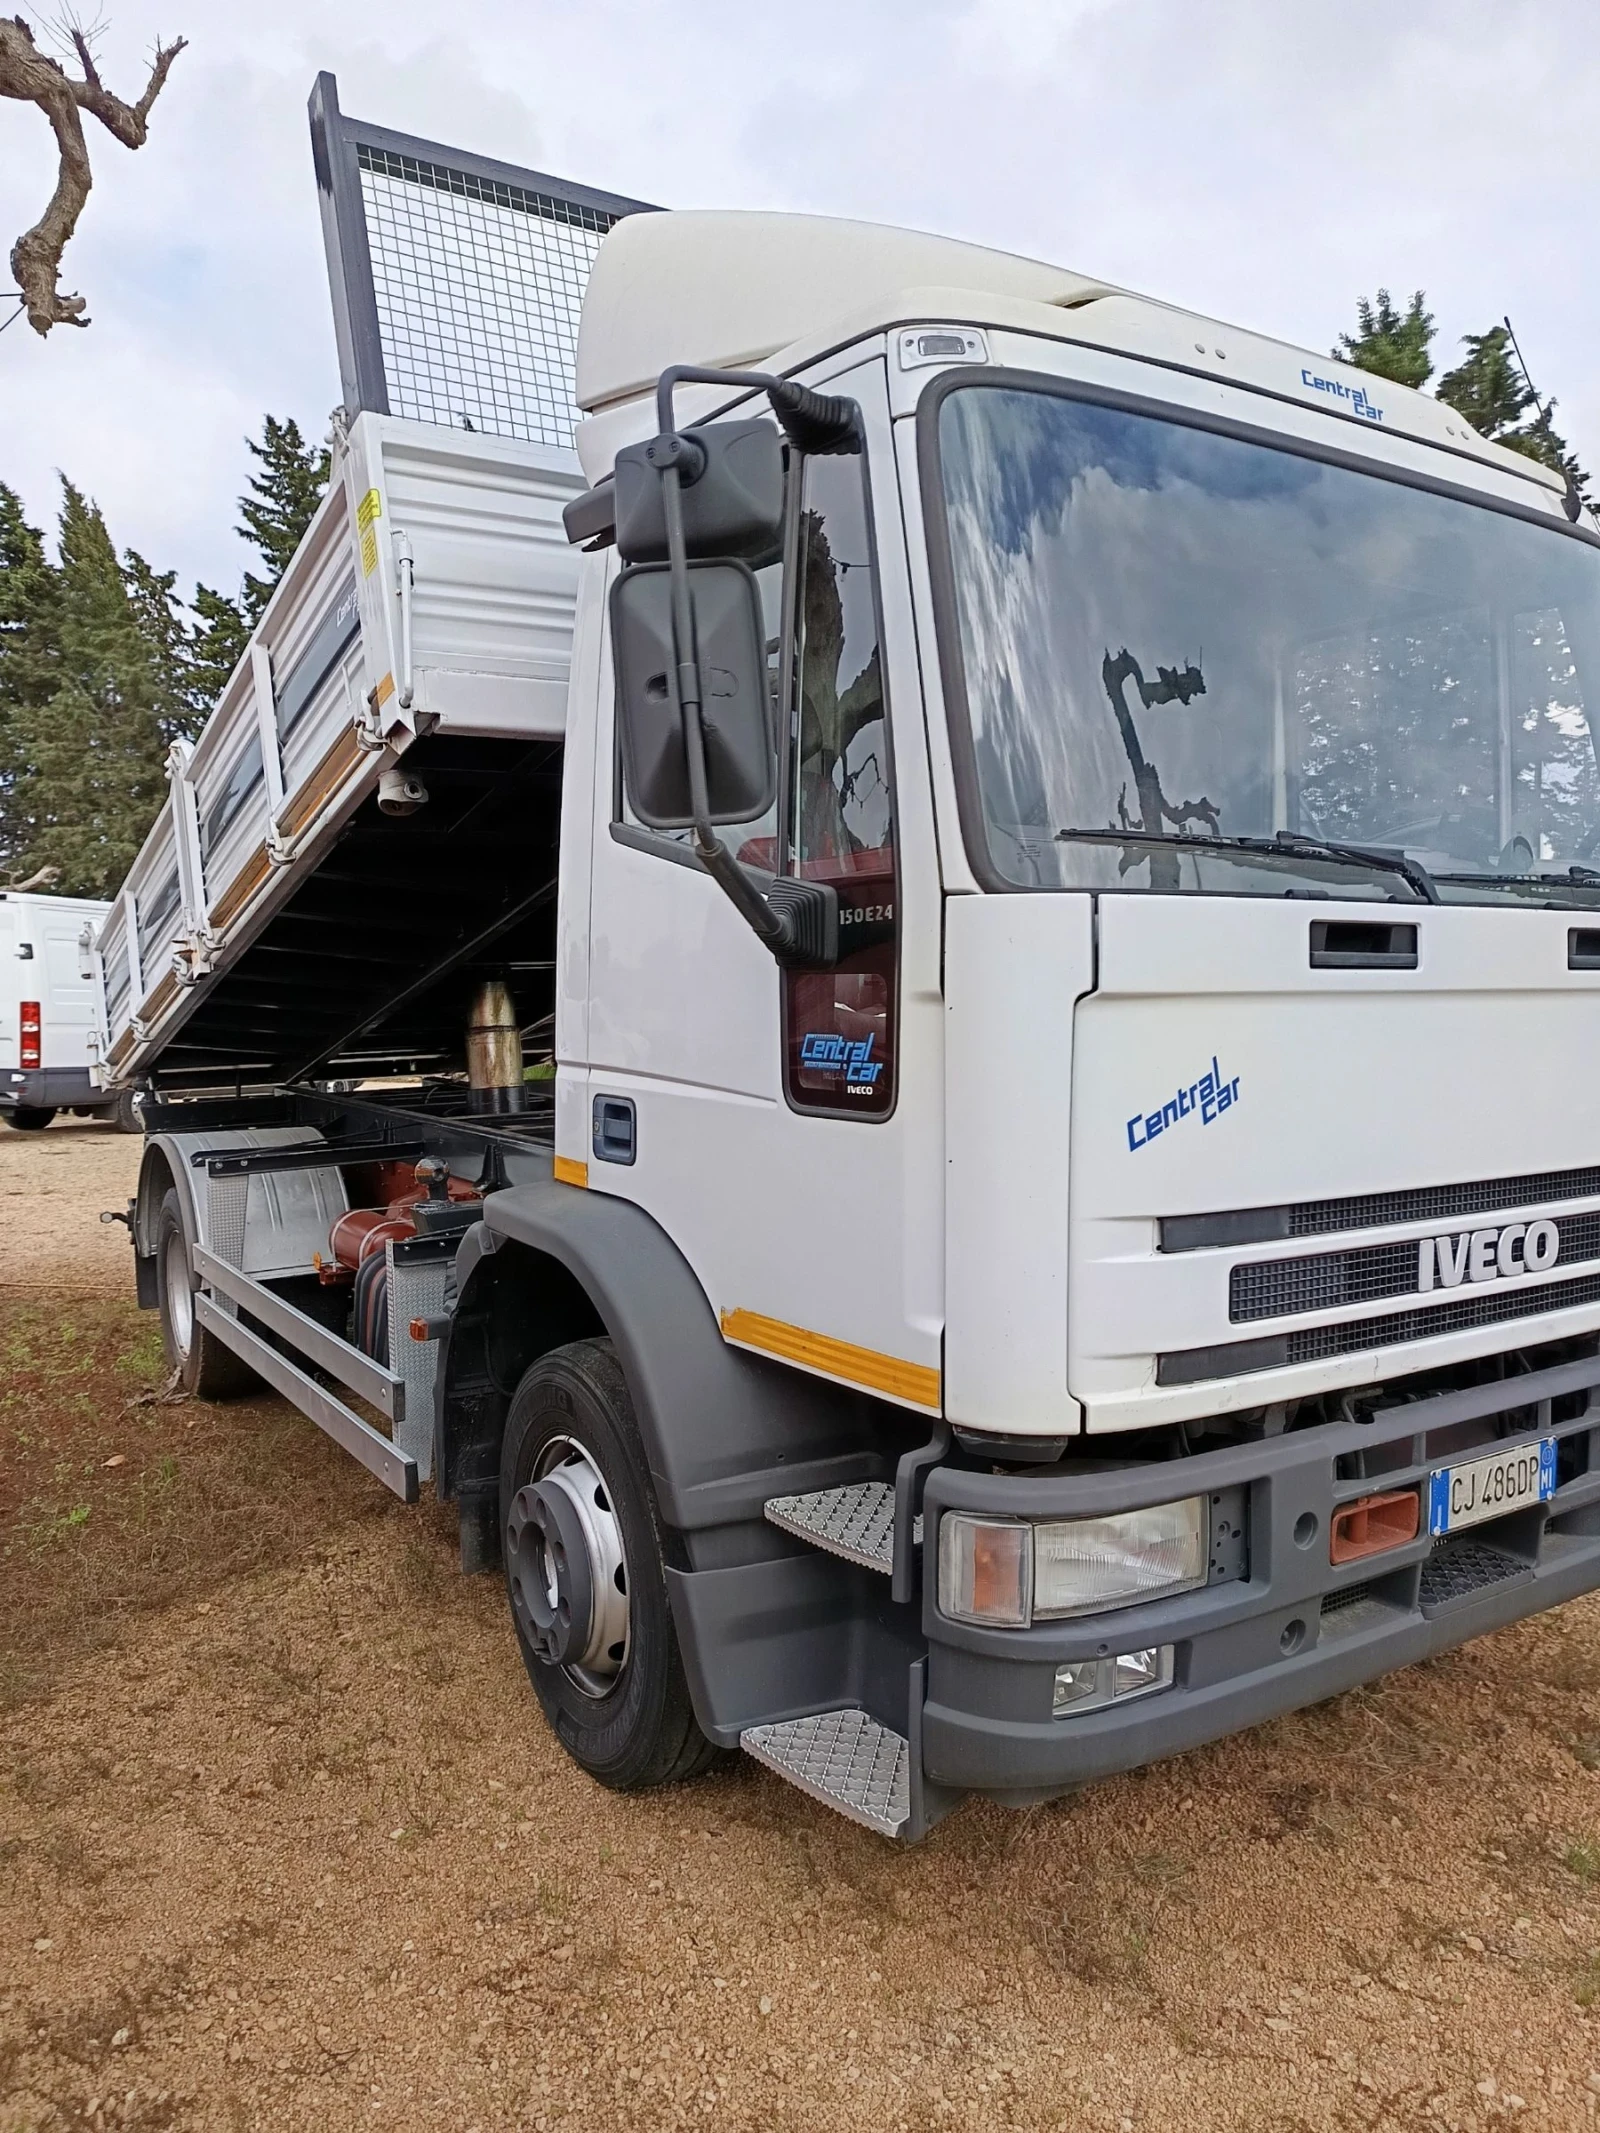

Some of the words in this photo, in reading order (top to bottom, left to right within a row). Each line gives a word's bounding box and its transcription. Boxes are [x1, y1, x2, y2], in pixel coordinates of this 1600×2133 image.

[1301, 368, 1368, 405] Central
[839, 904, 893, 925] 150E24
[801, 1032, 875, 1061] Central
[847, 1085, 873, 1095] IVECO
[1127, 1055, 1221, 1152] Central
[1418, 1219, 1560, 1293] IVECO
[1541, 1467, 1552, 1490] MI
